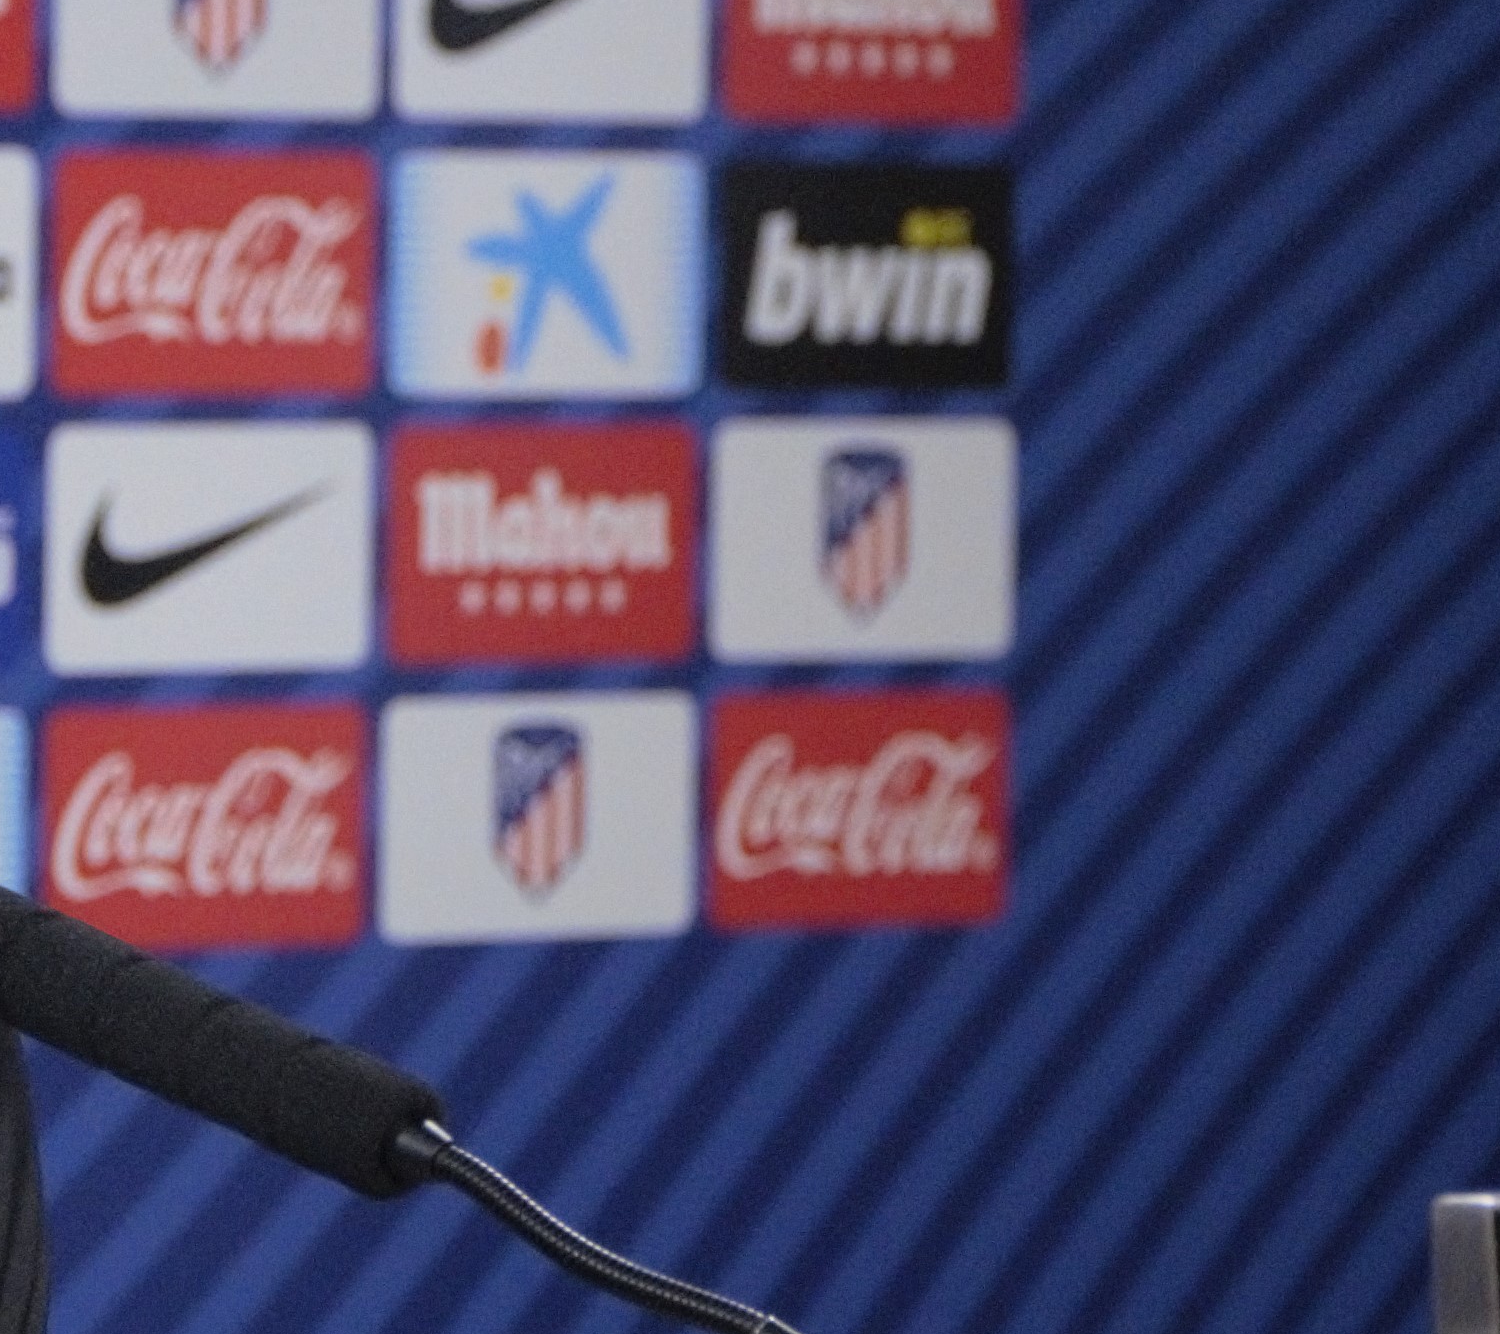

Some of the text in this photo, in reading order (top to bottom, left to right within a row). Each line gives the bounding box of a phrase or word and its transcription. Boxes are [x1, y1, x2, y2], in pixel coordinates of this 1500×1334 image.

[61, 197, 360, 343] Coca-Cola
[746, 212, 989, 343] bwin
[417, 471, 670, 569] Mahou
[52, 749, 350, 900] Coca-Cola
[715, 733, 994, 879] Coca-Cola
